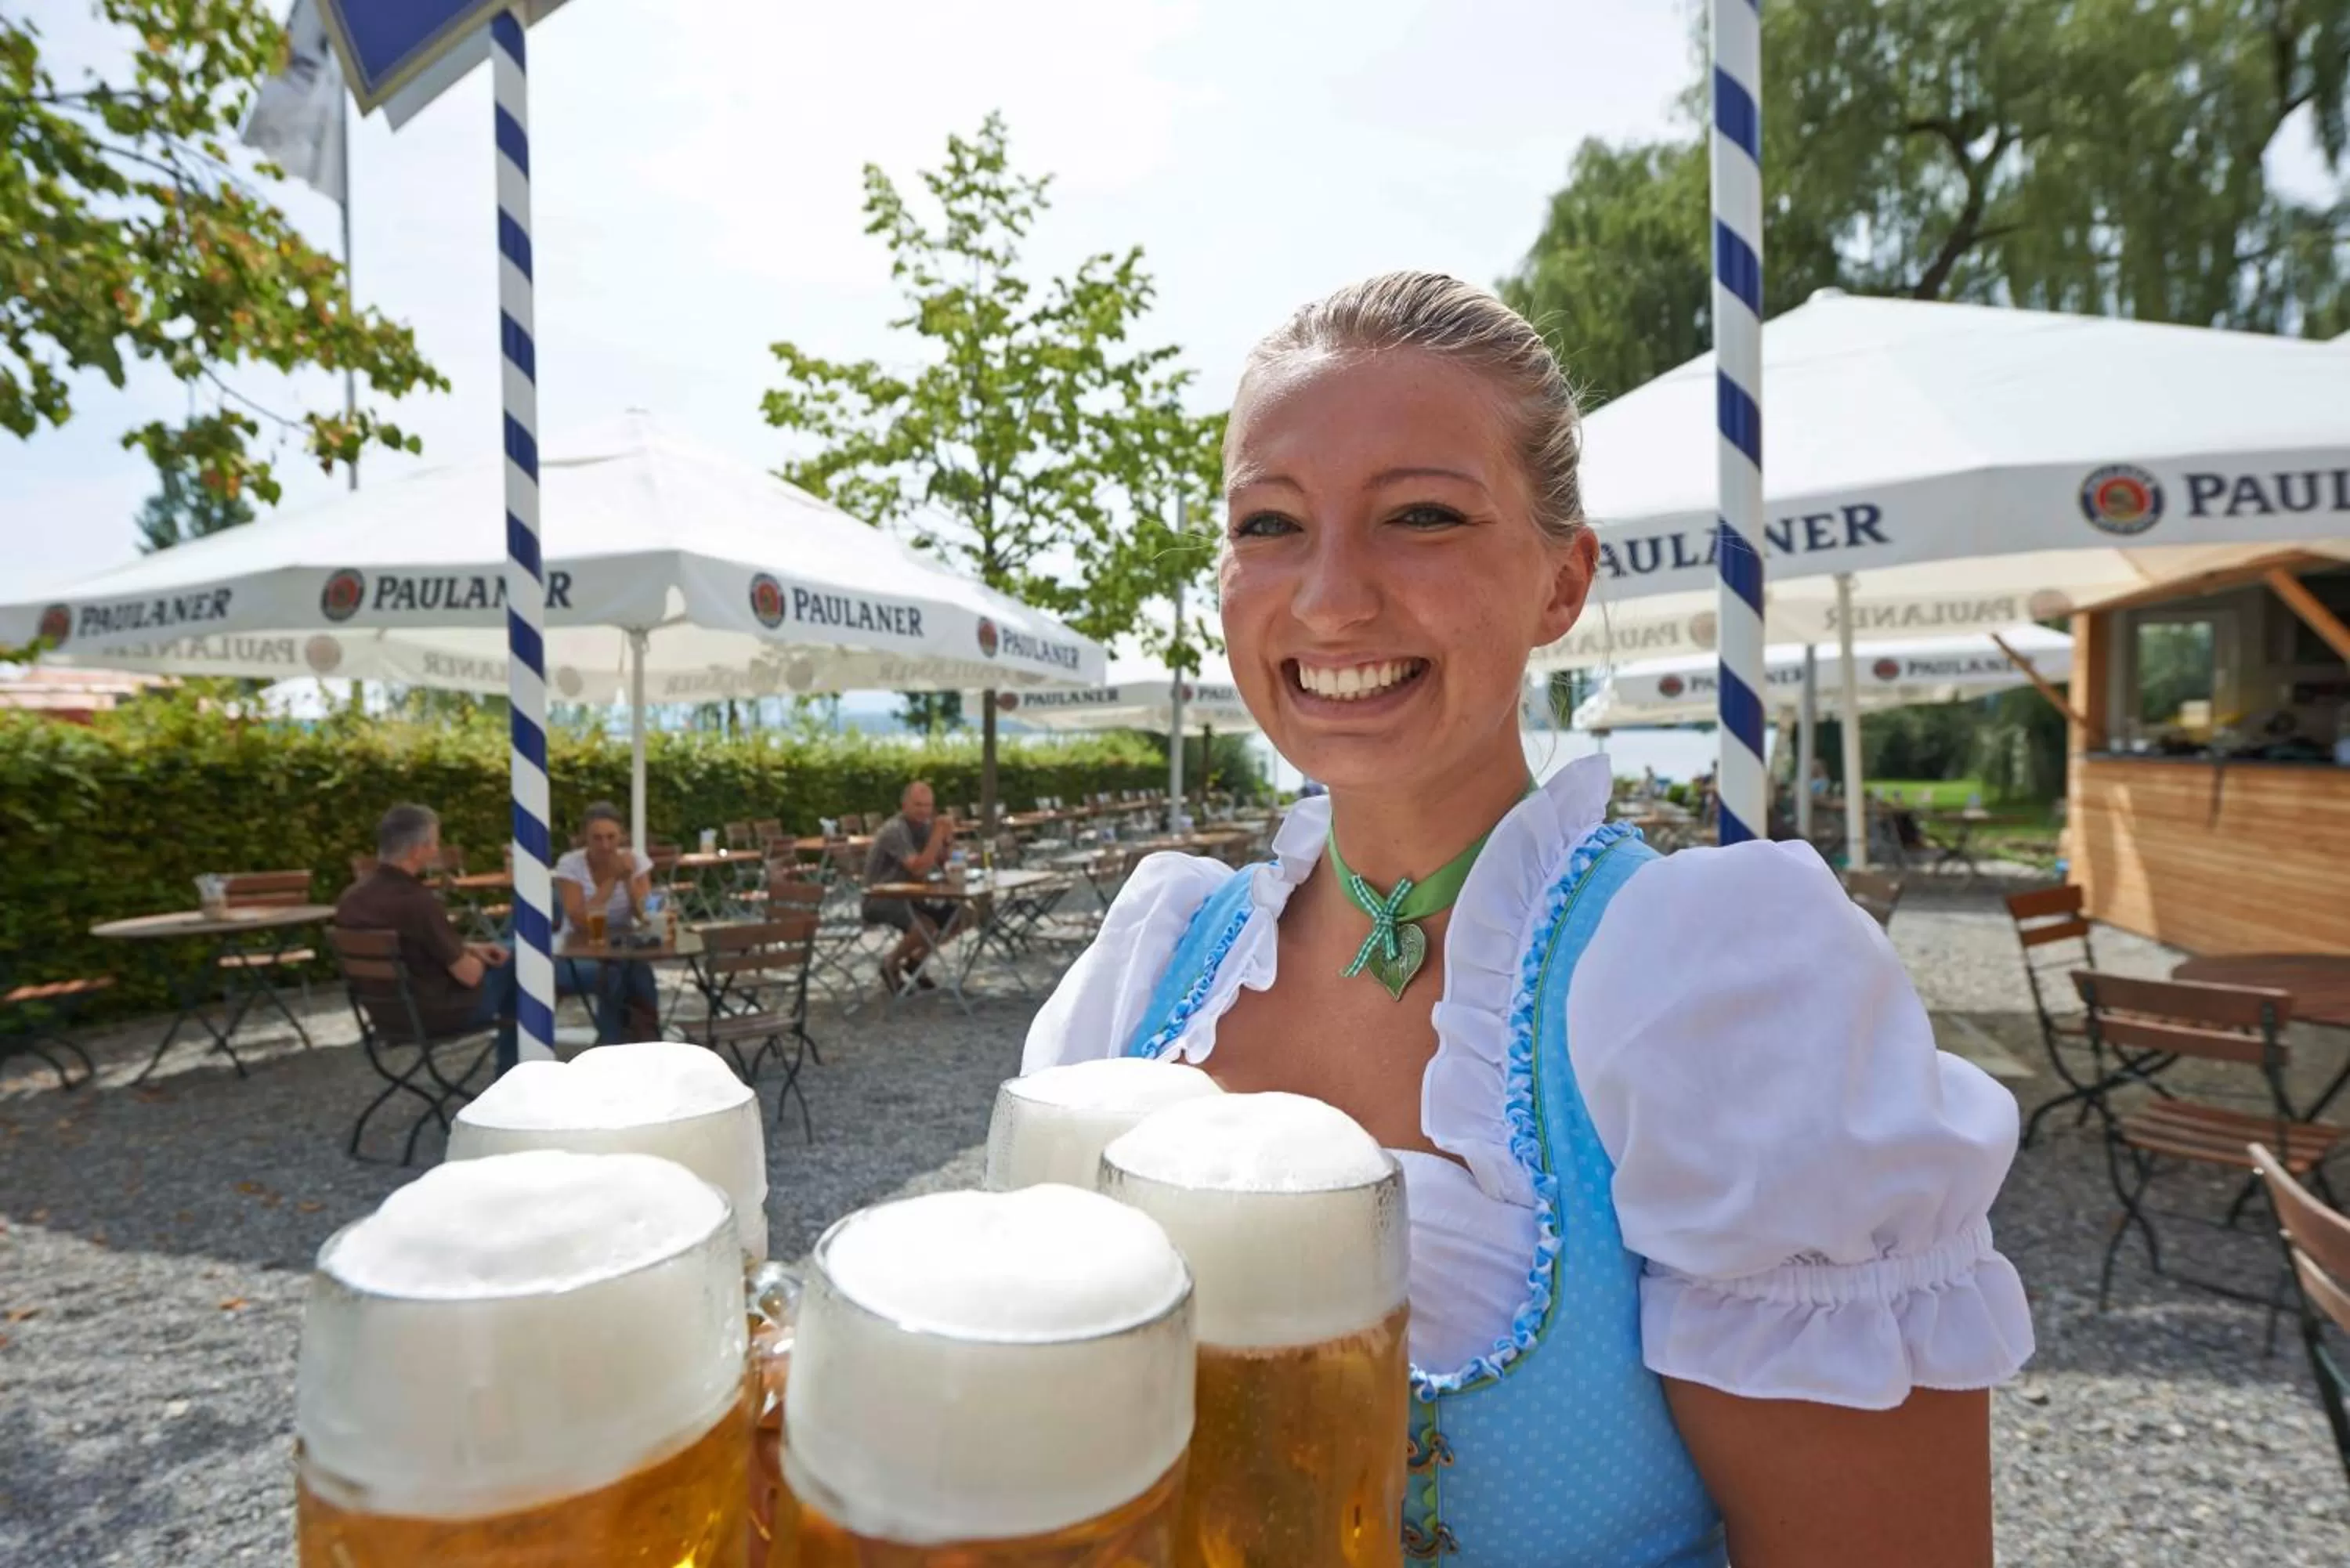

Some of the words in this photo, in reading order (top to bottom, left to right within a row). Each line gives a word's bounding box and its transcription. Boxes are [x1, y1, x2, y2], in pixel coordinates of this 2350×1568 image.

[1600, 502, 1893, 578] AULNER
[78, 587, 232, 638] PAULANER
[371, 569, 573, 611] PAULAR
[791, 586, 924, 638] PAULANER
[1002, 627, 1079, 669] PAULANER
[1023, 688, 1119, 707] PAULANER
